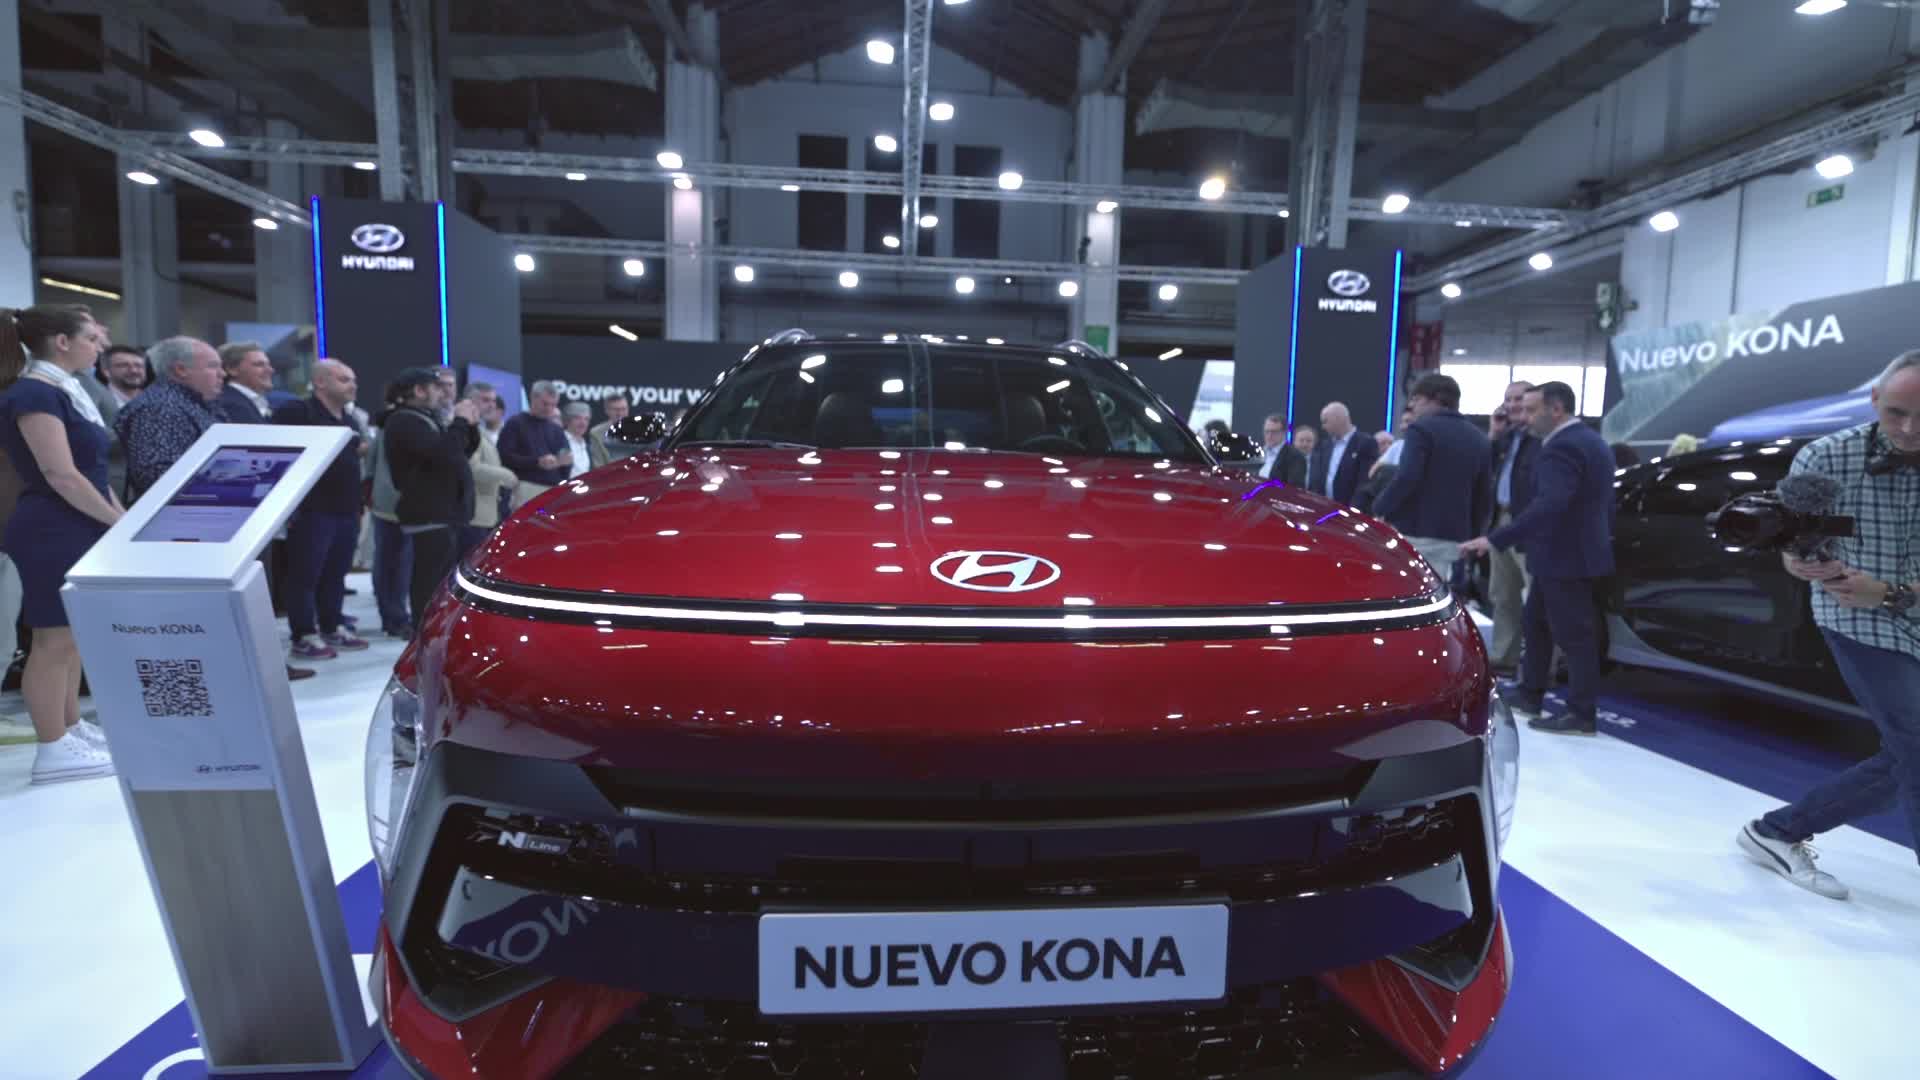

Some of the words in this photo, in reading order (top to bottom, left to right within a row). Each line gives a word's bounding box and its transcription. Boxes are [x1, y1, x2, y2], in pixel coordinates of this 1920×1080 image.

[341, 254, 415, 271] HYUNDAI
[1318, 297, 1377, 313] HYUNDAI
[1618, 339, 1718, 374] Nuevo
[1722, 313, 1845, 360] KONA
[552, 380, 626, 401] Power
[629, 384, 684, 407] your
[159, 623, 206, 634] KONA
[498, 831, 526, 848] N
[794, 942, 1007, 990] NUEVO
[1020, 935, 1186, 983] KONA
